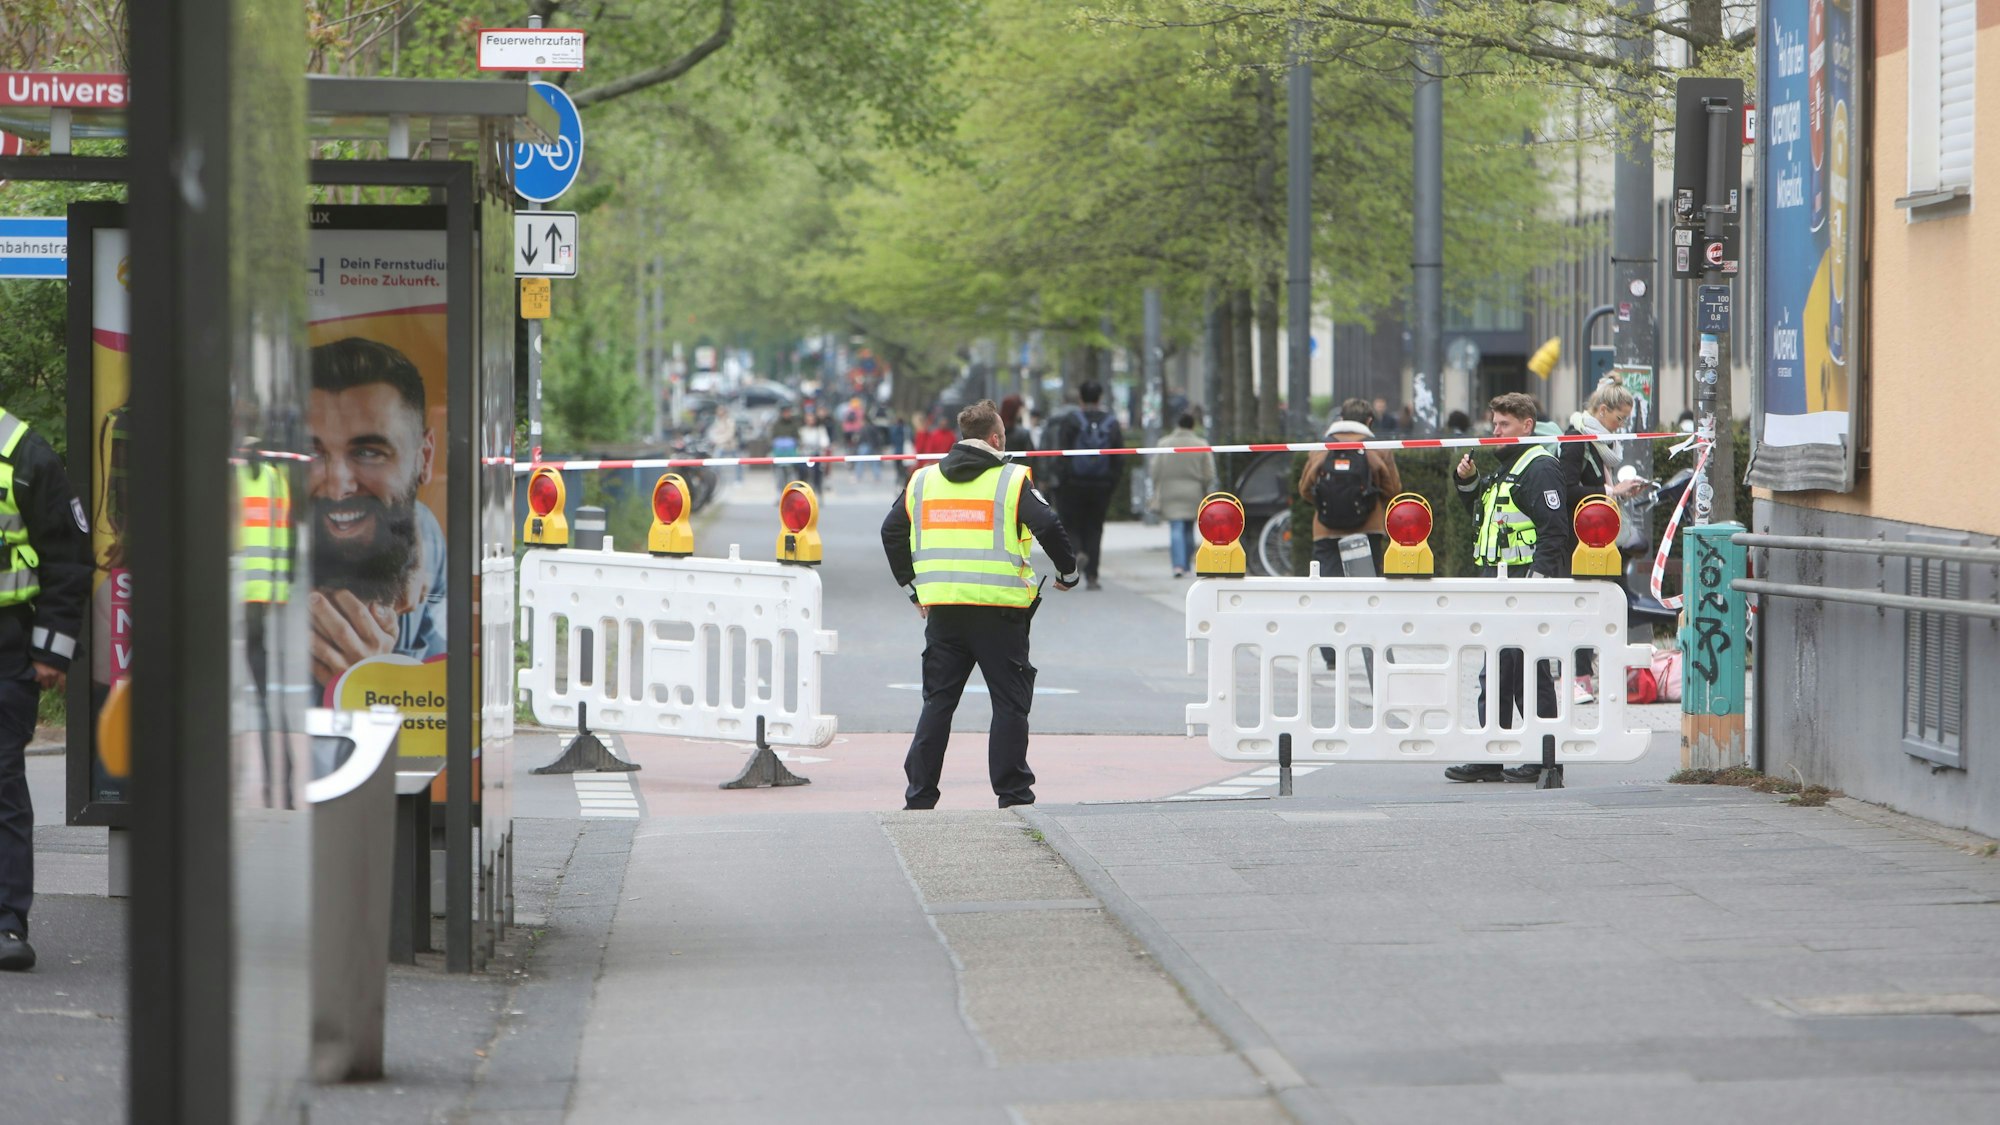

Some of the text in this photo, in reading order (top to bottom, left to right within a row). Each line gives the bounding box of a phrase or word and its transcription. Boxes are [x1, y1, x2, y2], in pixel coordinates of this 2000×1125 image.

[340, 258, 447, 271] Dein Fernstudiu
[340, 274, 440, 287] Deine Zukunft.
[1717, 295, 1730, 303] 100
[400, 716, 447, 730] aste
